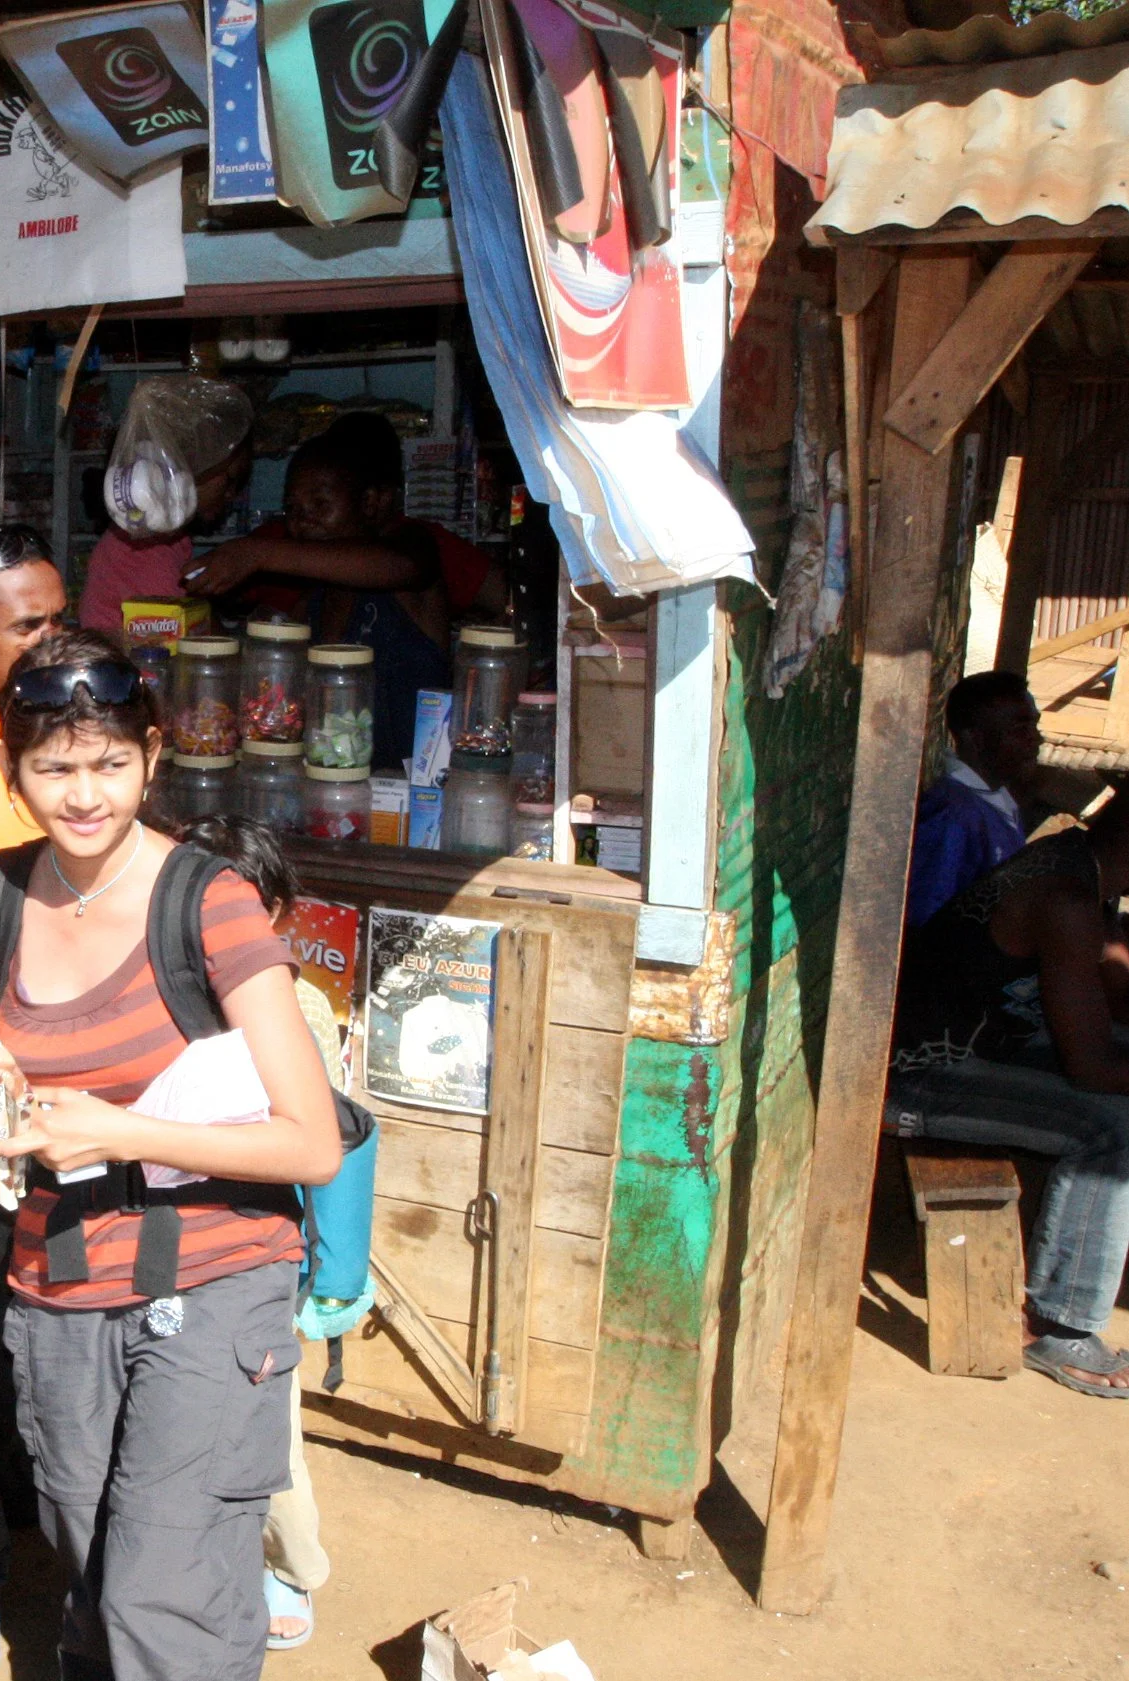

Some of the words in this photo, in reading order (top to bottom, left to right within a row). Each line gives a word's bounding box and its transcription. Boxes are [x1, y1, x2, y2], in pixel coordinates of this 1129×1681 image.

[215, 161, 273, 175] Manafotsy
[18, 214, 80, 240] AMBILOBE
[433, 959, 491, 980] AZUR
